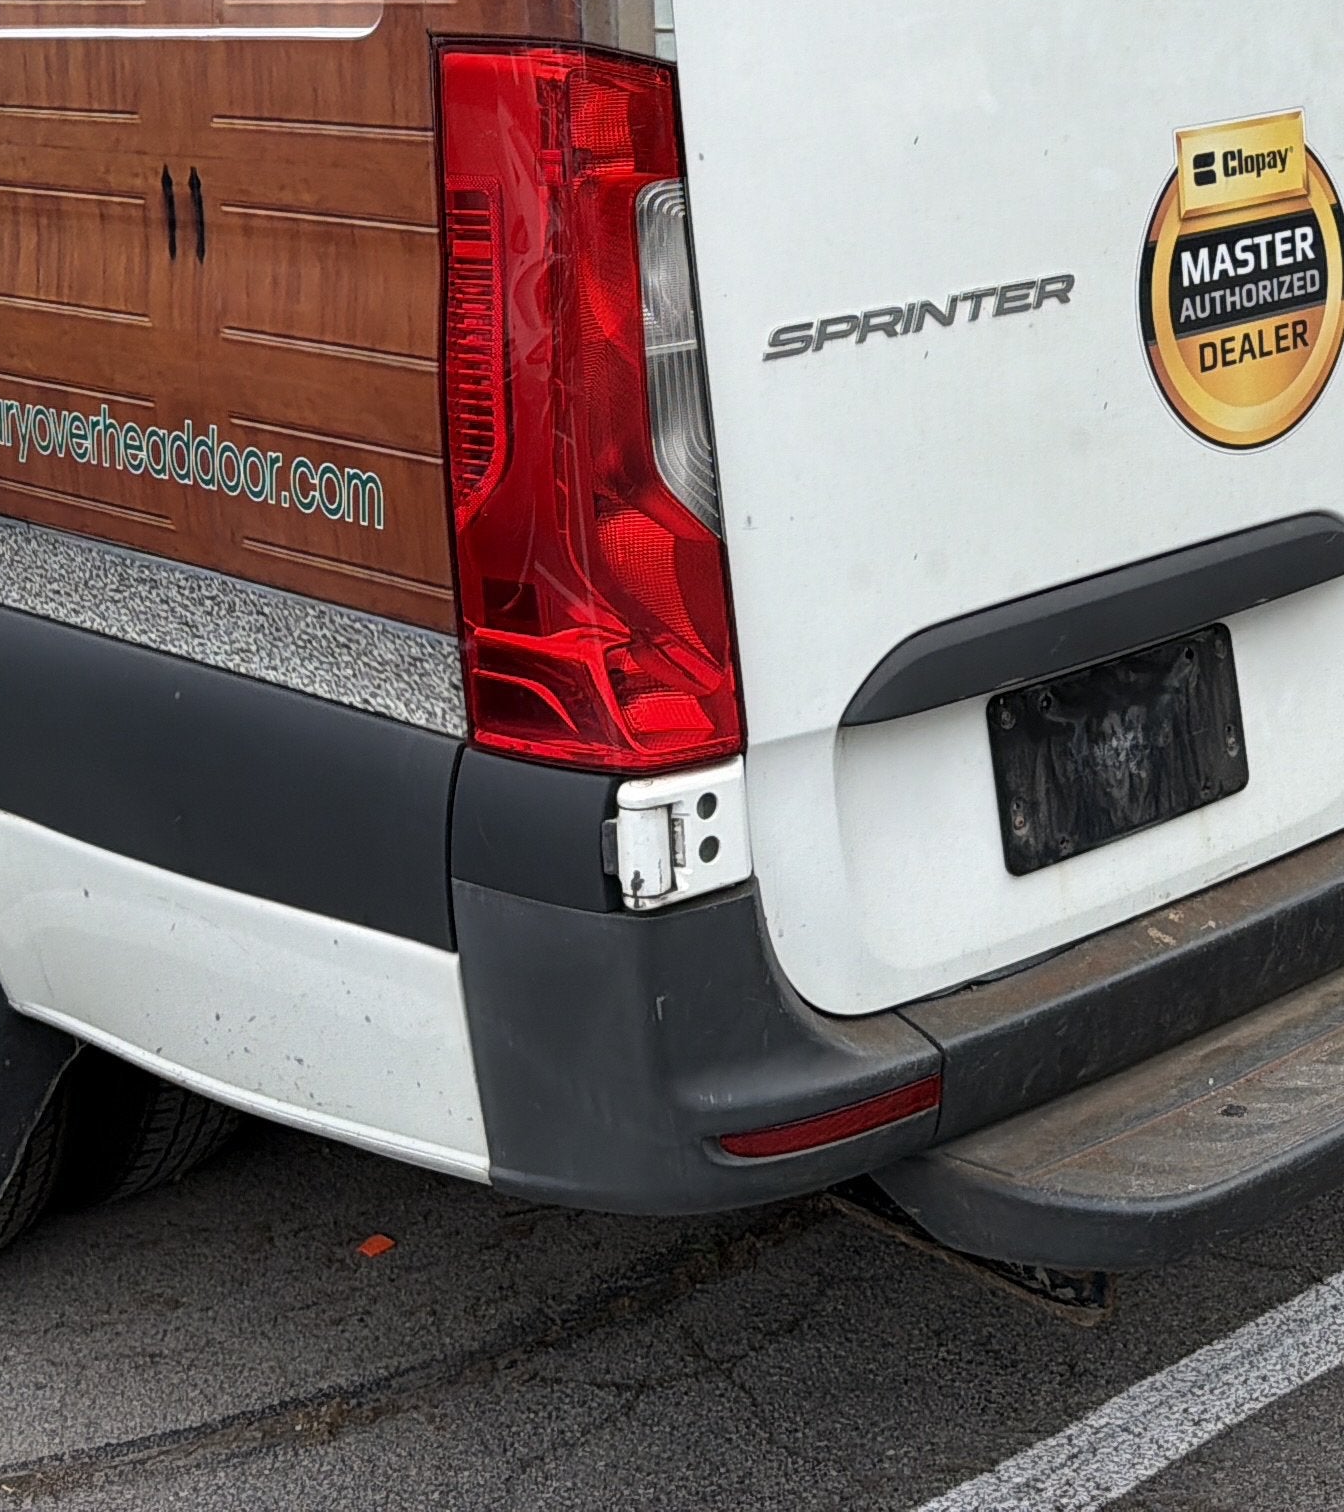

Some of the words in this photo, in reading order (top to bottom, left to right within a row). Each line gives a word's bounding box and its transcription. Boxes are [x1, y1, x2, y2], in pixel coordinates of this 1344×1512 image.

[1222, 147, 1290, 179] Clopay
[1180, 225, 1315, 288] MASTER
[762, 272, 1076, 361] SPRINTER
[1179, 268, 1320, 324] AUTHORIZED
[1198, 319, 1309, 373] DEALER
